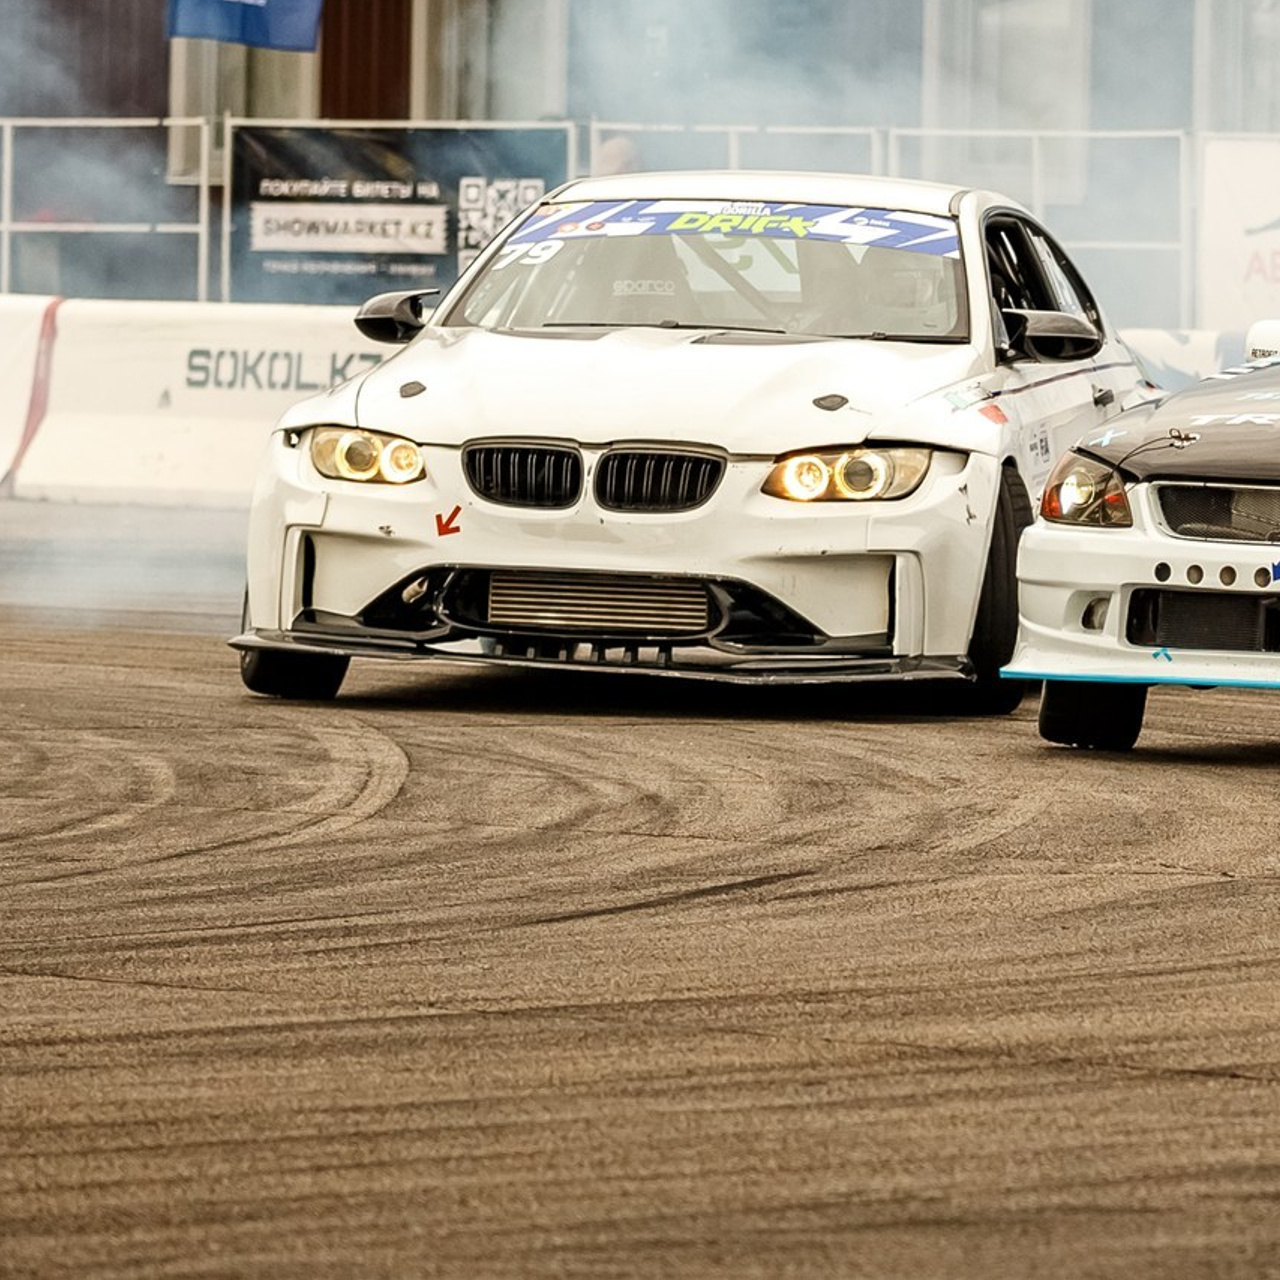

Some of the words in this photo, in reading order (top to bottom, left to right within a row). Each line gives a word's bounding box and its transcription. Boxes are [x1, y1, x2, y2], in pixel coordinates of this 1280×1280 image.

[666, 212, 816, 237] DRIFT
[490, 239, 566, 271] 79
[613, 279, 676, 294] sparco
